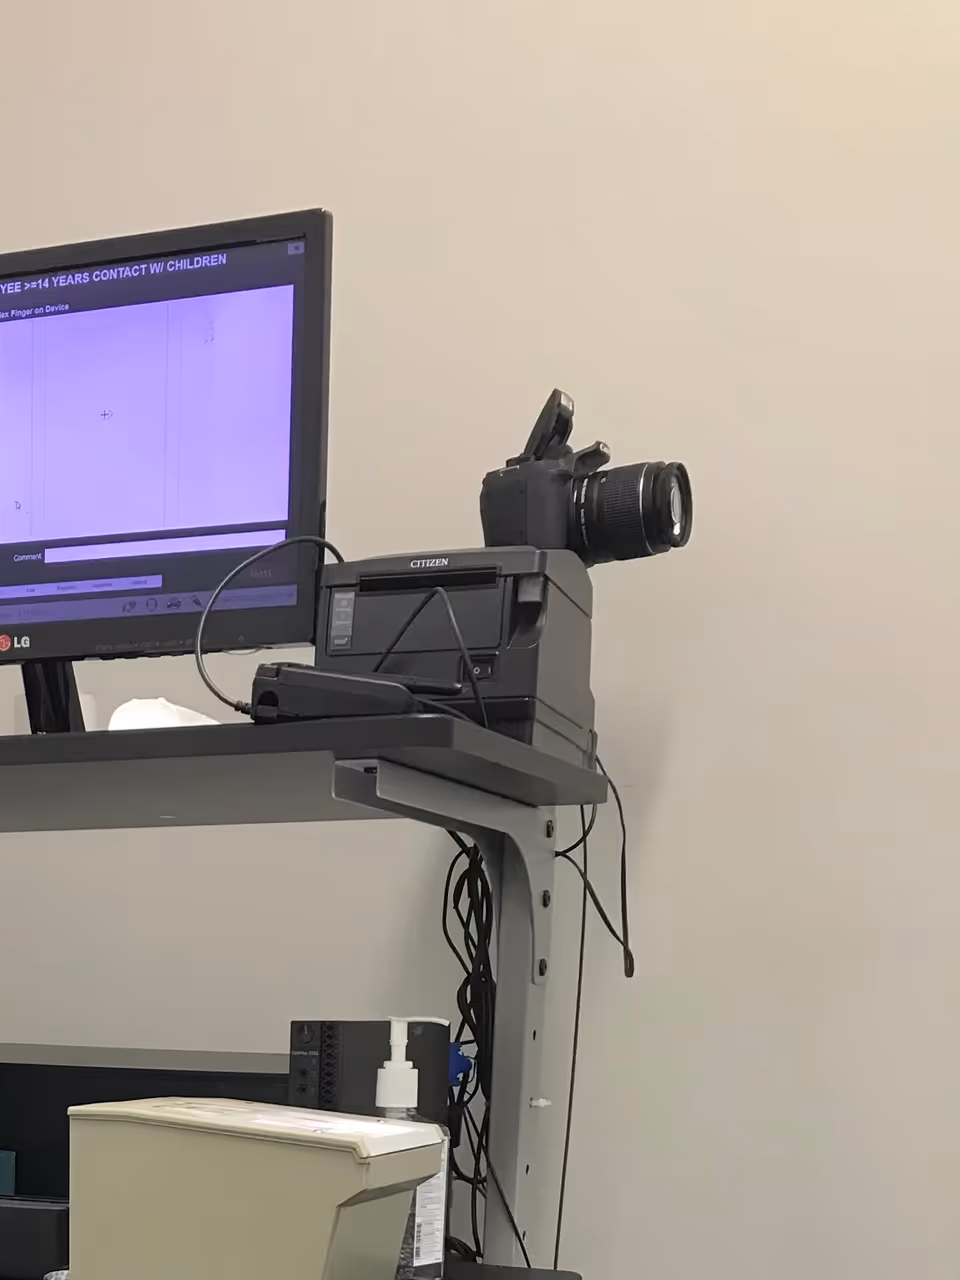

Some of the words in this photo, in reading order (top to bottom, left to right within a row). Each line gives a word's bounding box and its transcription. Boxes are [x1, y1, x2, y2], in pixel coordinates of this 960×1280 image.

[24, 277, 49, 291] >=14
[51, 272, 89, 288] YEARS
[92, 264, 147, 282] CONTACT
[149, 261, 164, 275] W/
[166, 253, 227, 272] CHILDREN
[11, 308, 33, 318] Finger
[34, 307, 44, 315] on
[45, 303, 69, 313] Device
[13, 552, 42, 563] Comment
[410, 557, 449, 568] CITIZEN
[14, 636, 30, 648] LG
